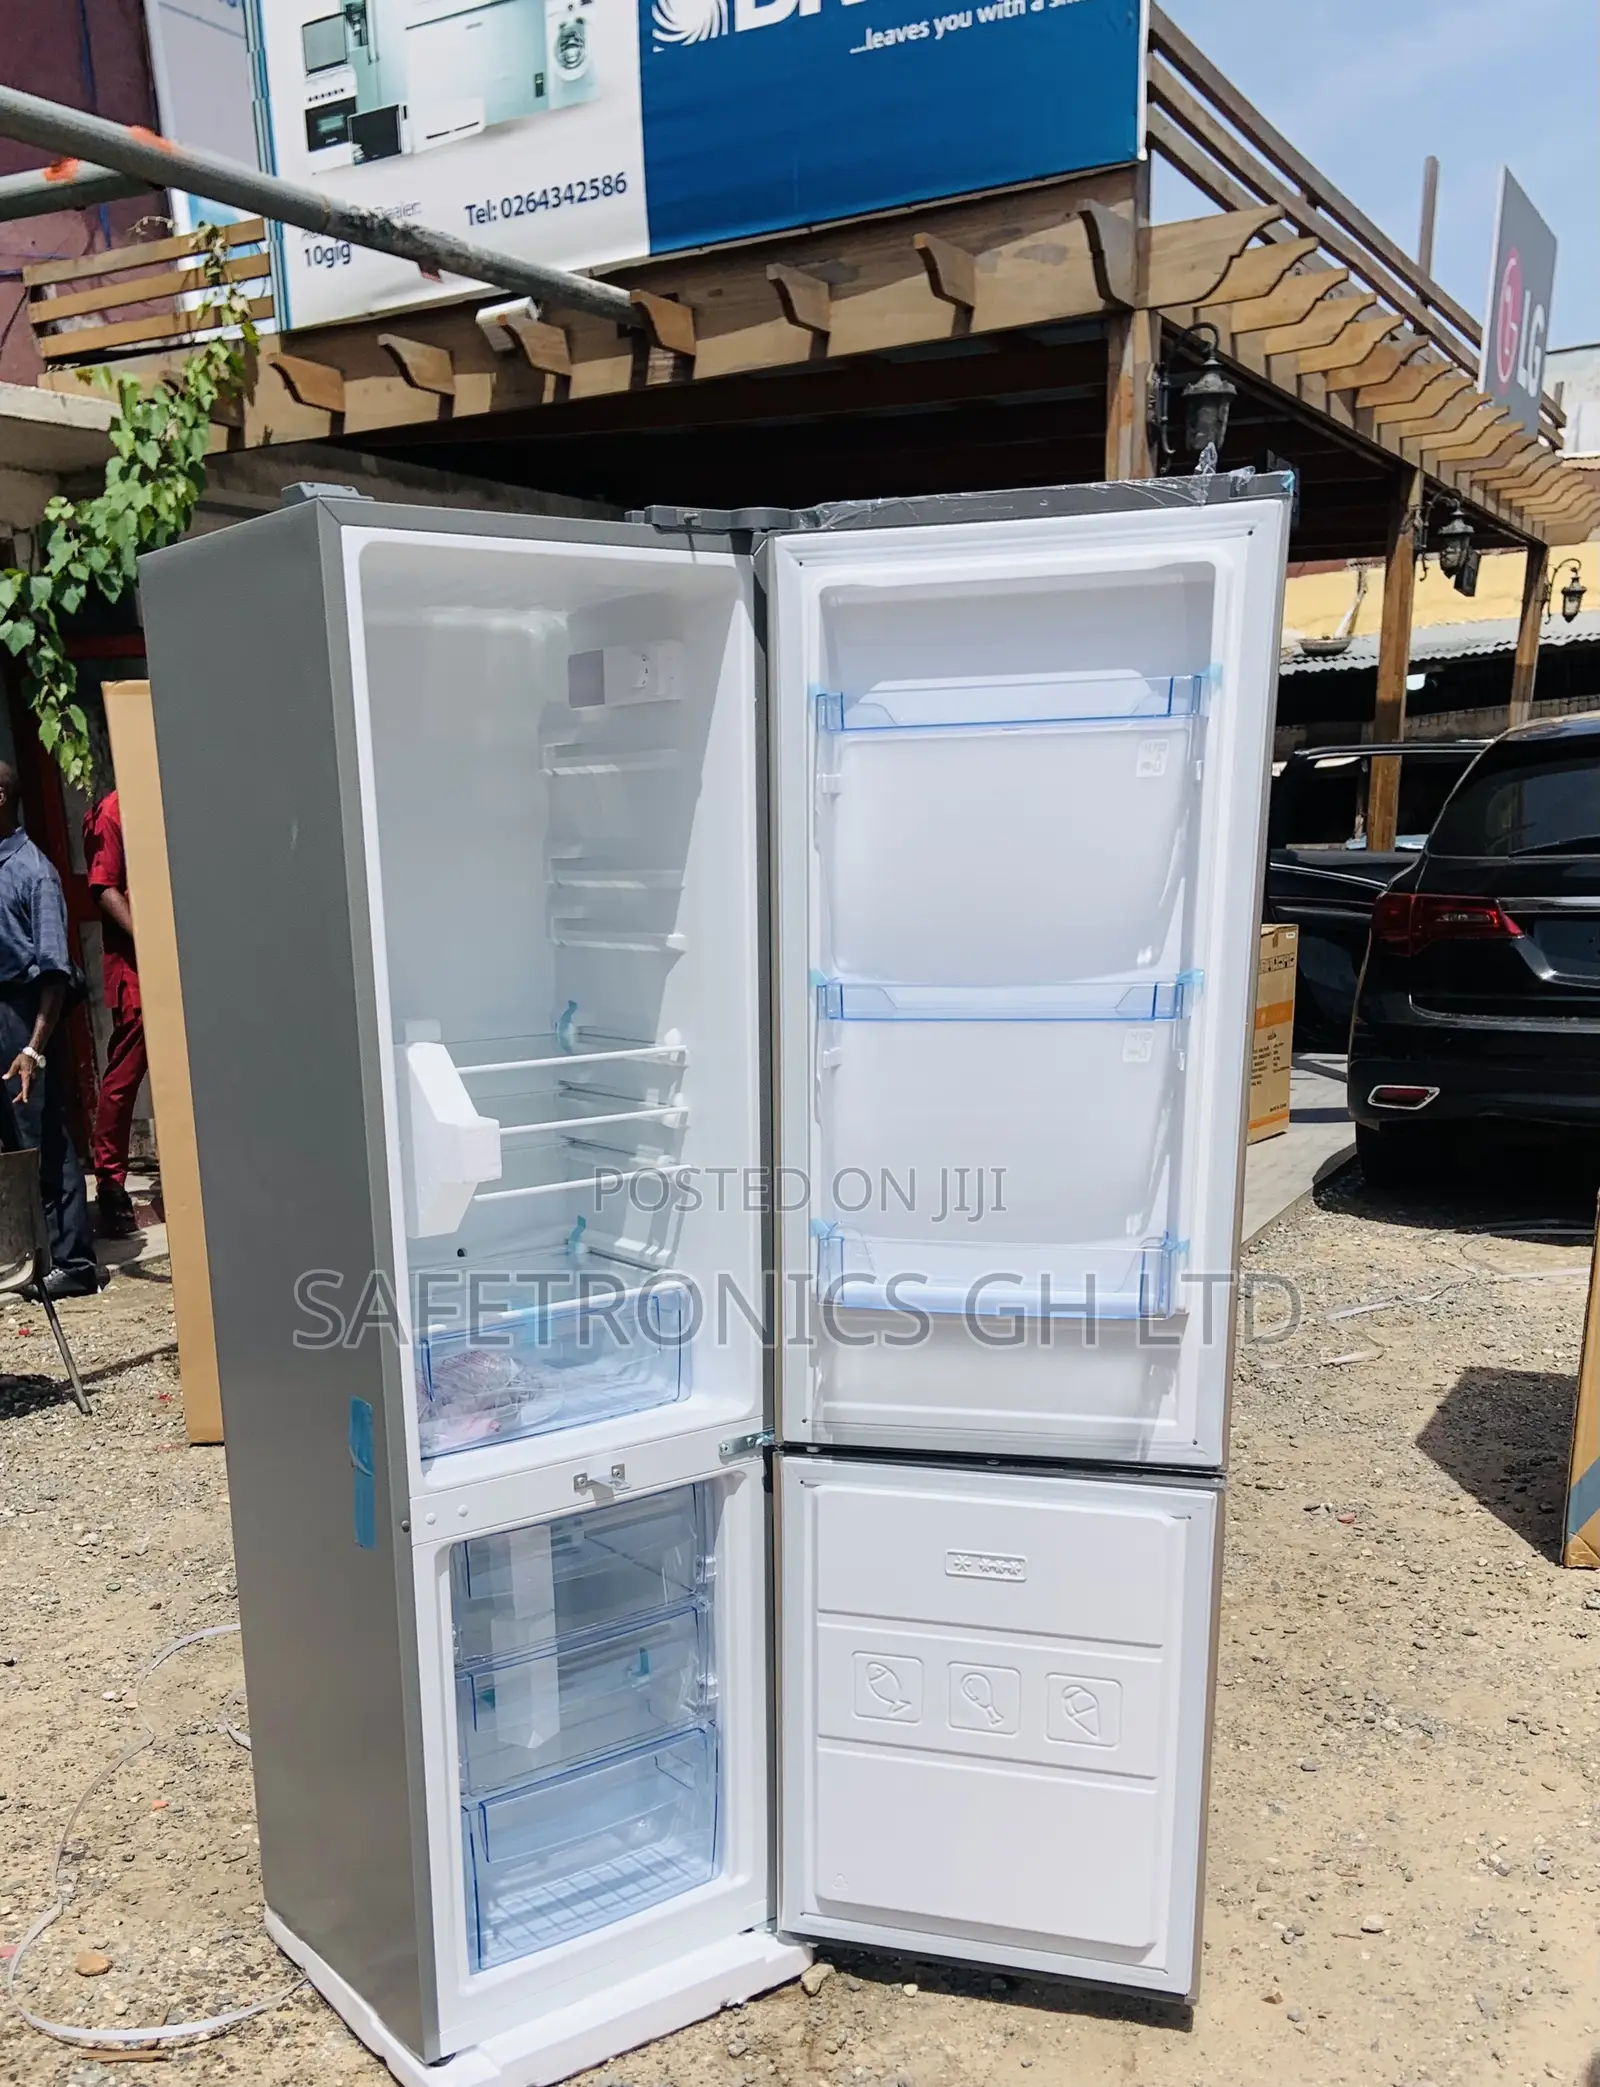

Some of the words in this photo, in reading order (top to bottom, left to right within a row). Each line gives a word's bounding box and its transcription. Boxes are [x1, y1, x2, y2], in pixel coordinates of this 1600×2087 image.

[933, 10, 972, 40] you
[976, 0, 1026, 24] with
[464, 199, 498, 226] Tel:
[500, 171, 628, 219] 0264342586
[1516, 290, 1546, 398] LG
